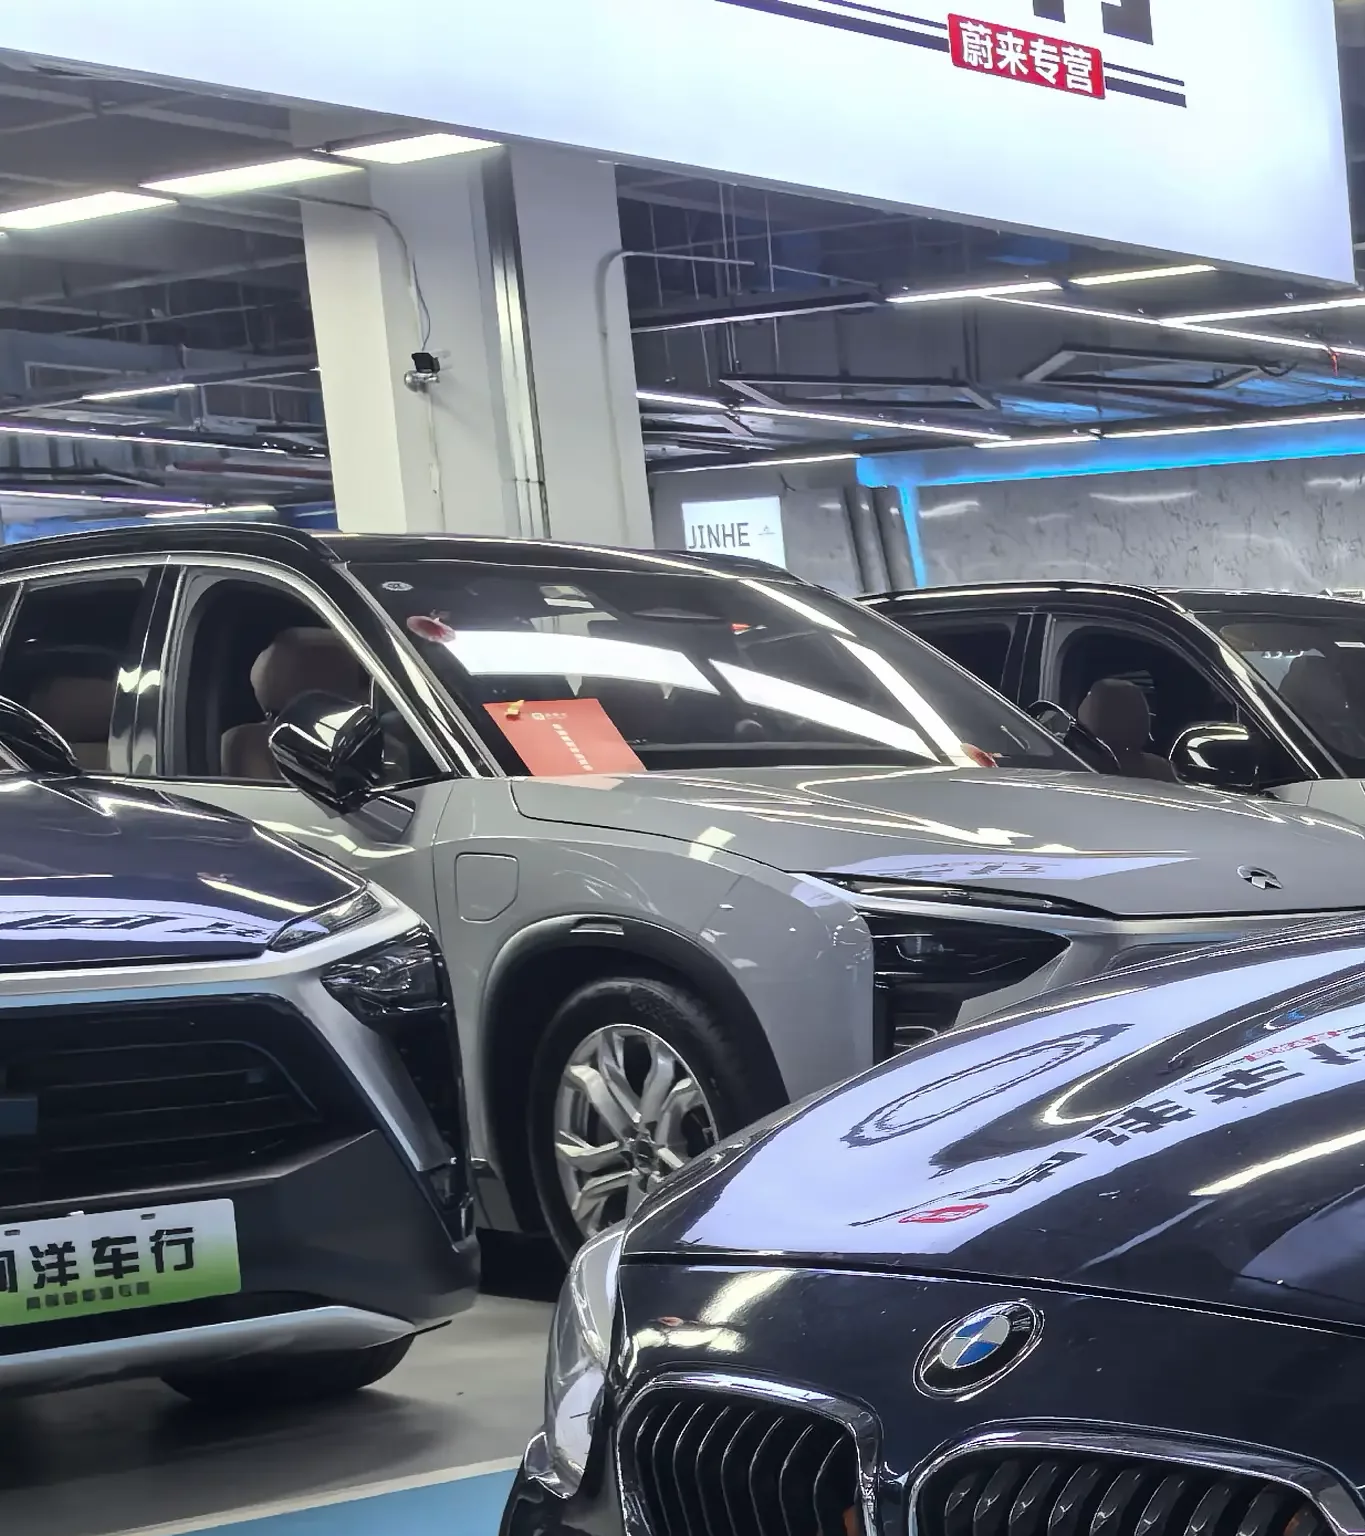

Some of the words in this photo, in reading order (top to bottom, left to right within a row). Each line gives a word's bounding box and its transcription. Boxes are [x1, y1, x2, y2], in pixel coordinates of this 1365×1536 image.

[959, 21, 1093, 94] 蔚来专营
[688, 523, 751, 549] JINHE
